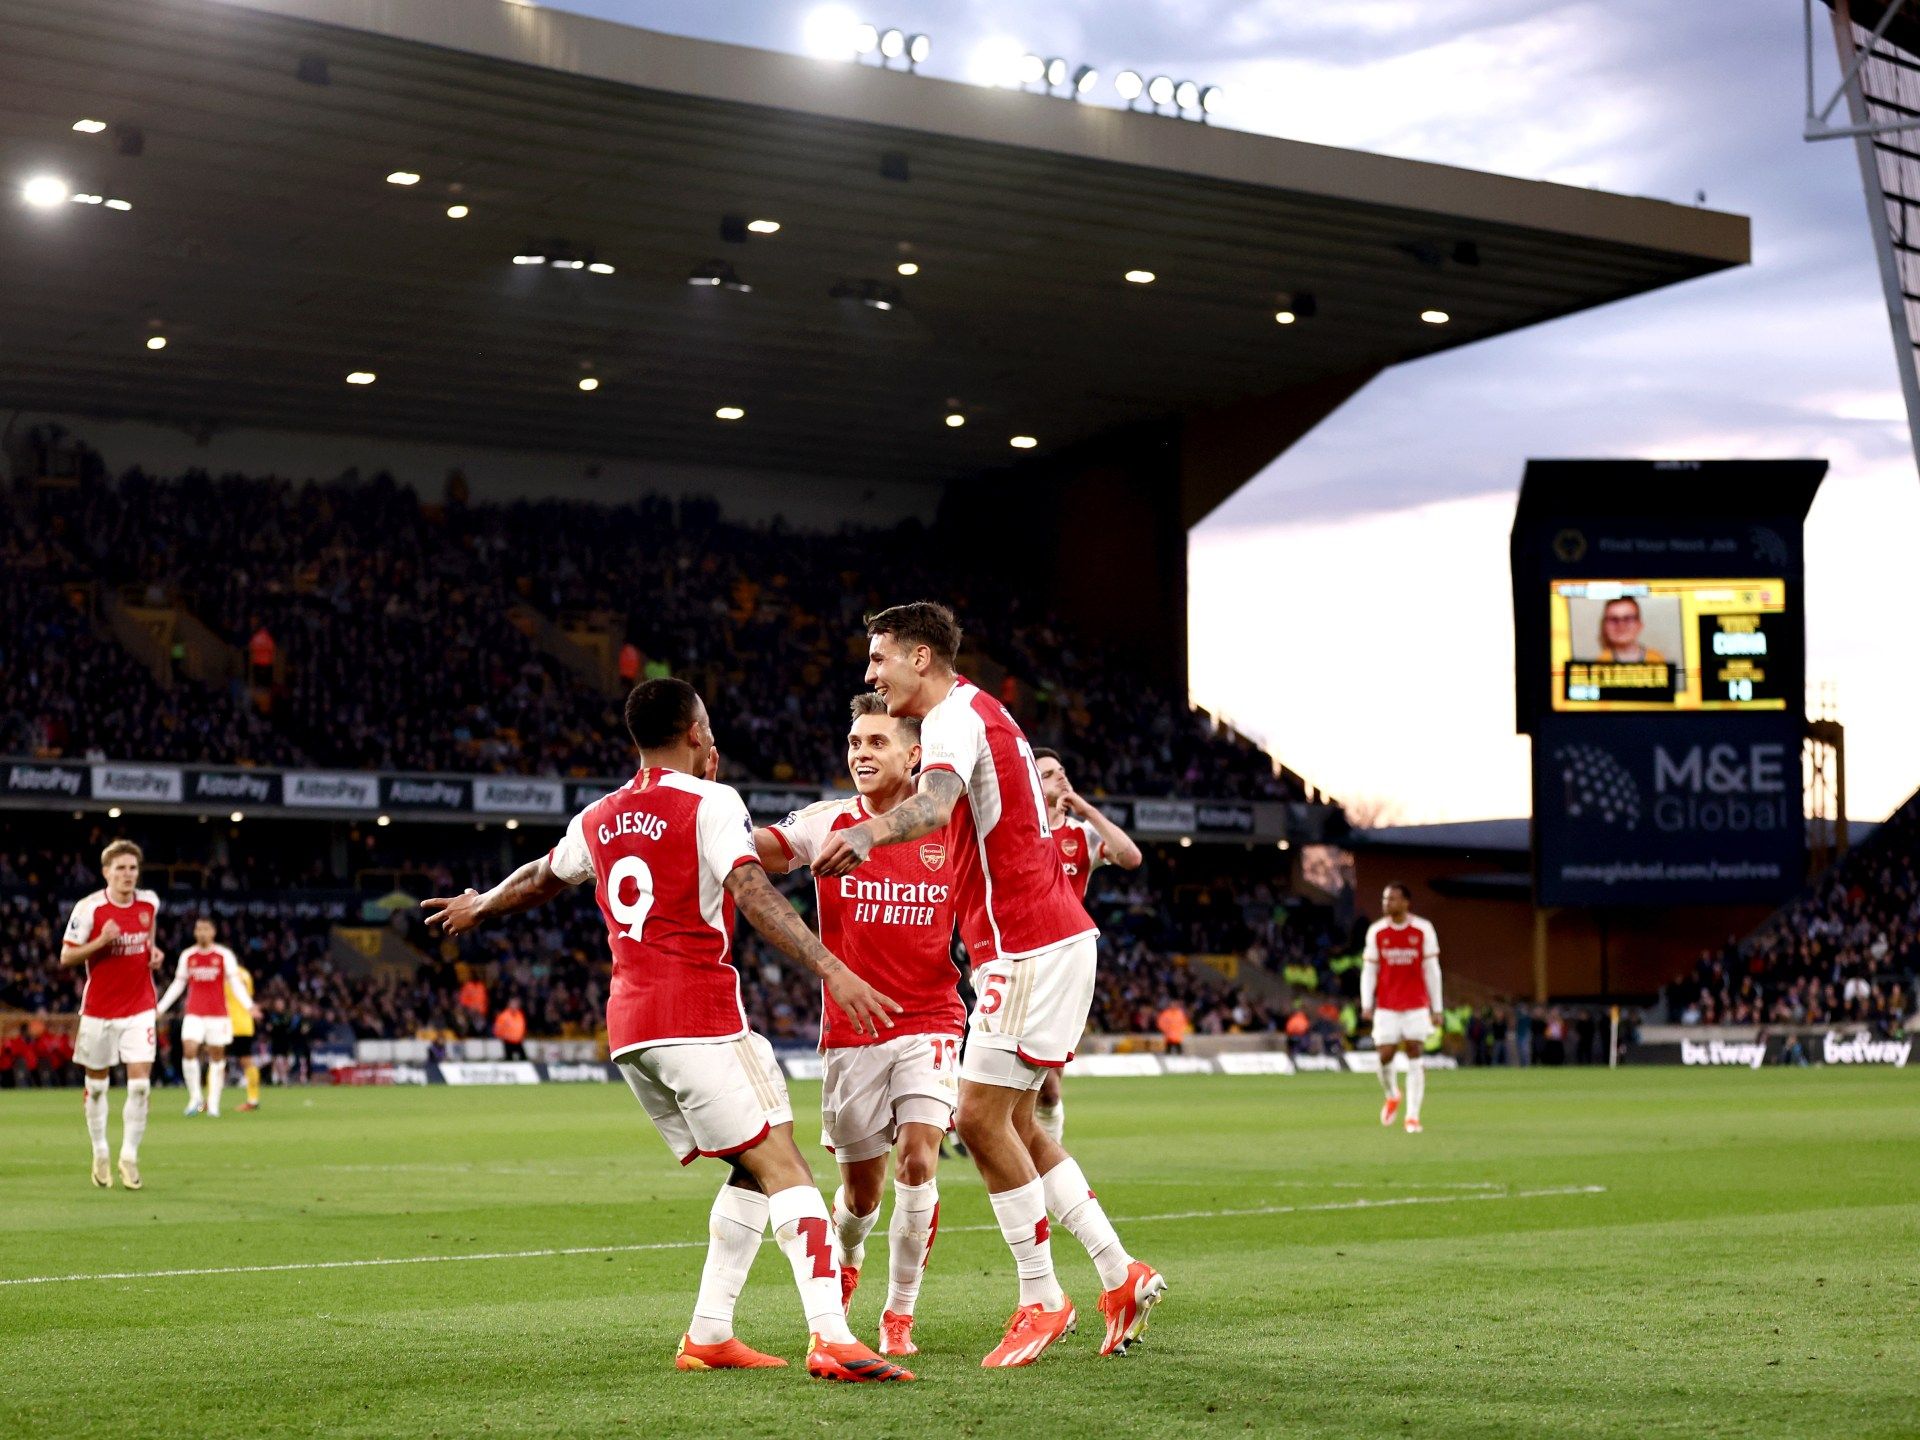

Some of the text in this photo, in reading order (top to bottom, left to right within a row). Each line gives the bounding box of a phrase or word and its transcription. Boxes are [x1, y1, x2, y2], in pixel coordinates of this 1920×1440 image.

[1655, 745, 1785, 792] M&E
[598, 812, 667, 845] G.JESUS
[1655, 796, 1788, 831] Global
[608, 856, 655, 942] 9
[841, 875, 949, 903] Emirates
[855, 903, 934, 926] FLY BETTER
[1823, 1031, 1912, 1068] betway
